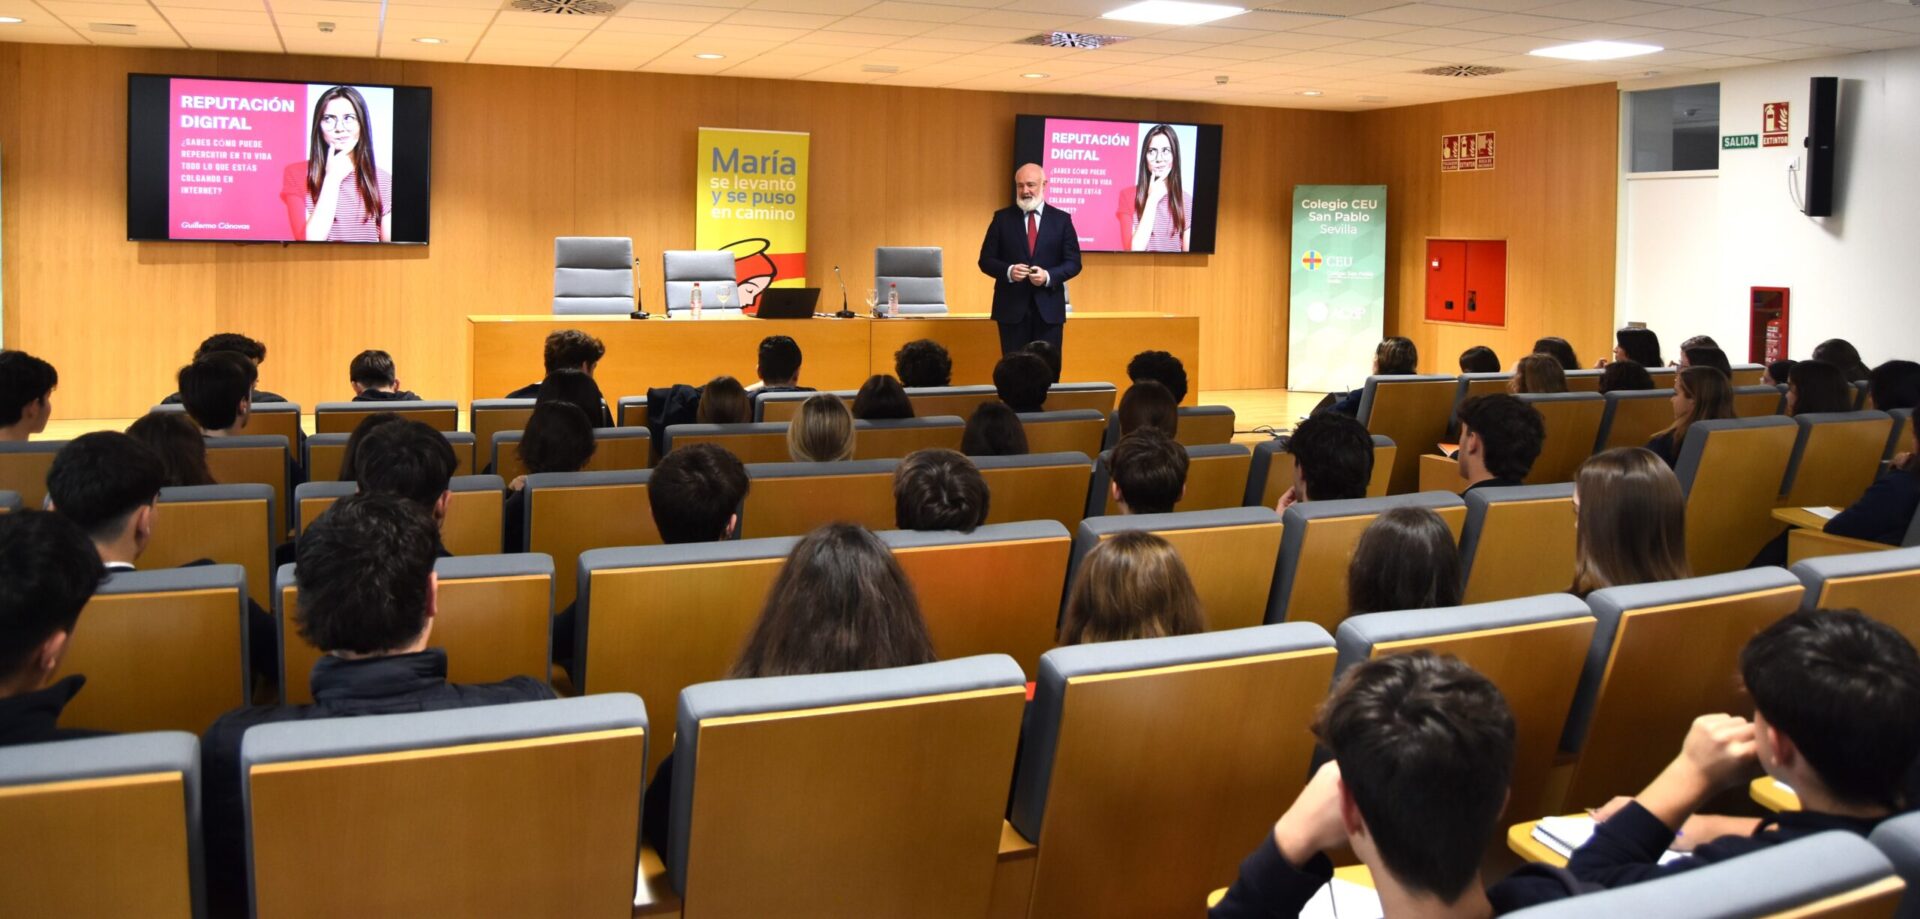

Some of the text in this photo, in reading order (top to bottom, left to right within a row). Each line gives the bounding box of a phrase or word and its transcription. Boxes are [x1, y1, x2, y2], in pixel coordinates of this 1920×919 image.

[181, 95, 294, 112] REPUTACIÓN
[181, 116, 252, 130] DIGITAL
[181, 138, 263, 148] ¿SABES CÓMO PUEDE
[1052, 132, 1130, 146] REPUTACIÓN
[1724, 136, 1756, 147] SALIDA
[1763, 136, 1788, 145] EXTINTOR
[181, 150, 272, 160] REPERCUTIR EN TU VIDA
[1051, 148, 1100, 161] DIGITAL
[181, 162, 200, 170] TODO
[215, 163, 229, 171] QUE
[232, 163, 257, 171] ESTÁS
[712, 147, 796, 175] María
[181, 174, 233, 183] COLGANDO EN
[710, 175, 796, 191] se levantó
[181, 186, 222, 195] INTERNET?
[711, 190, 796, 206] y se puso
[1302, 199, 1378, 212] Colegio CEU
[711, 207, 796, 221] en camino
[1308, 211, 1370, 222] San Pablo
[181, 221, 216, 229] Guillermo
[1320, 223, 1357, 235] Sevilla
[1326, 255, 1353, 267] CEU
